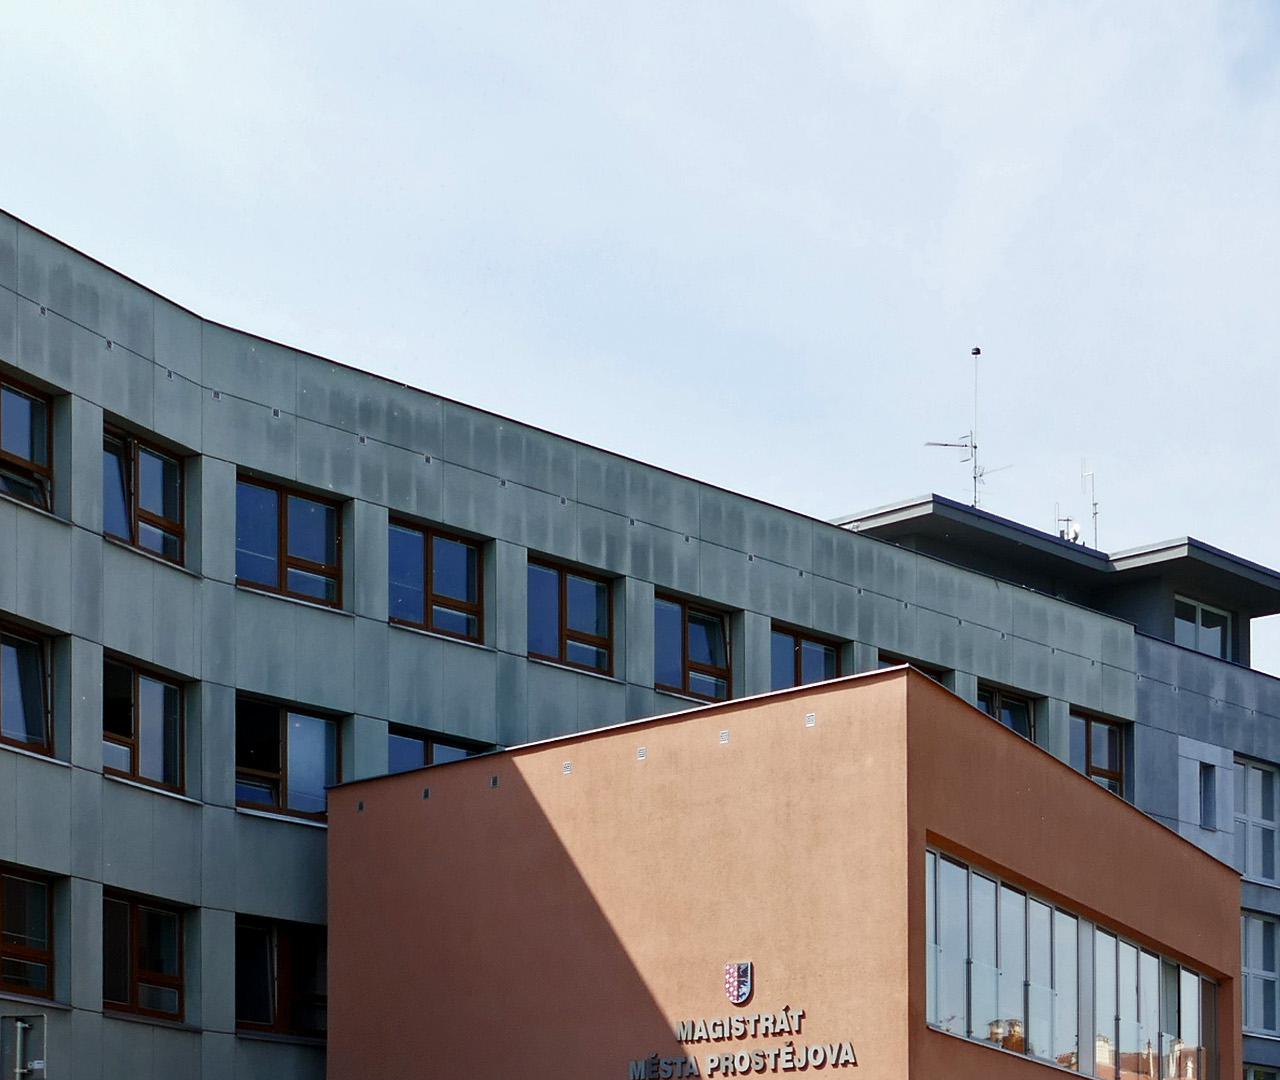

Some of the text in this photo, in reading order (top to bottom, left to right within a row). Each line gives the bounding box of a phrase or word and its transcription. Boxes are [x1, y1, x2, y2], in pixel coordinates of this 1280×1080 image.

[676, 1006, 805, 1043] MAGISTRÁT
[628, 1041, 858, 1080] MĚSTA PROSTĚJOVA
